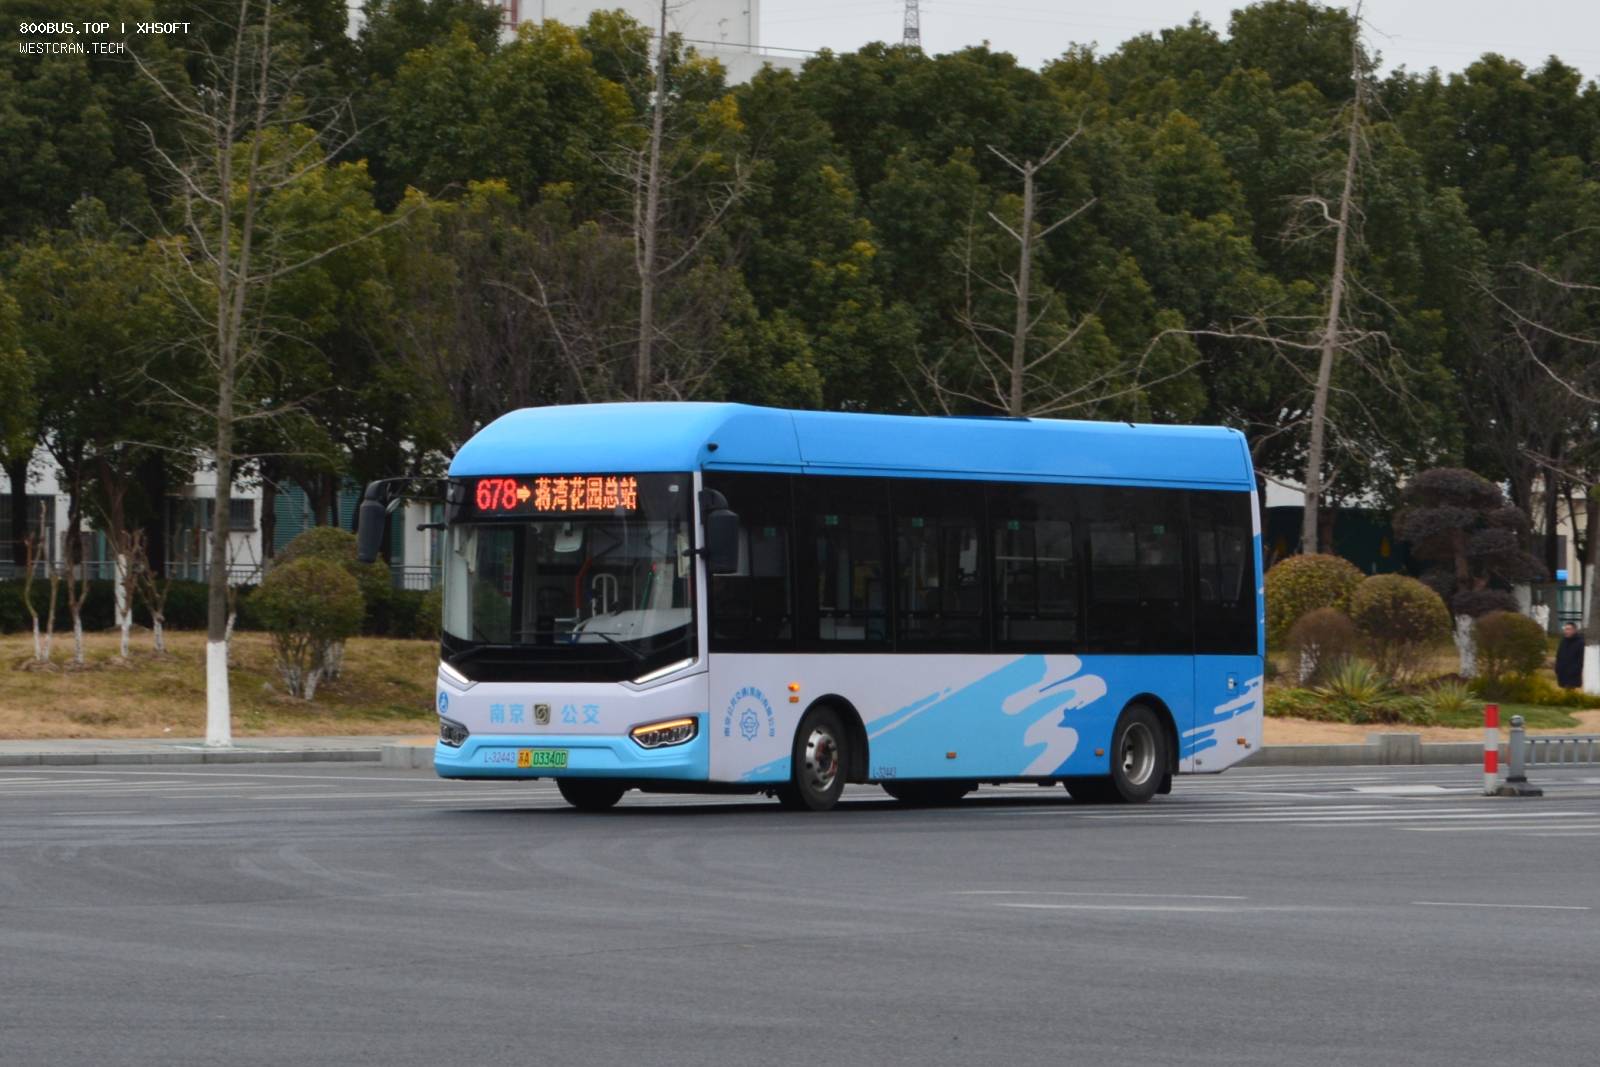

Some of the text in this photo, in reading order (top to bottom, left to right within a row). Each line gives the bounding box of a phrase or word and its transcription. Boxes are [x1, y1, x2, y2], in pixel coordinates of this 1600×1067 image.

[476, 479, 517, 510] 678
[490, 704, 599, 724] 南京 公交
